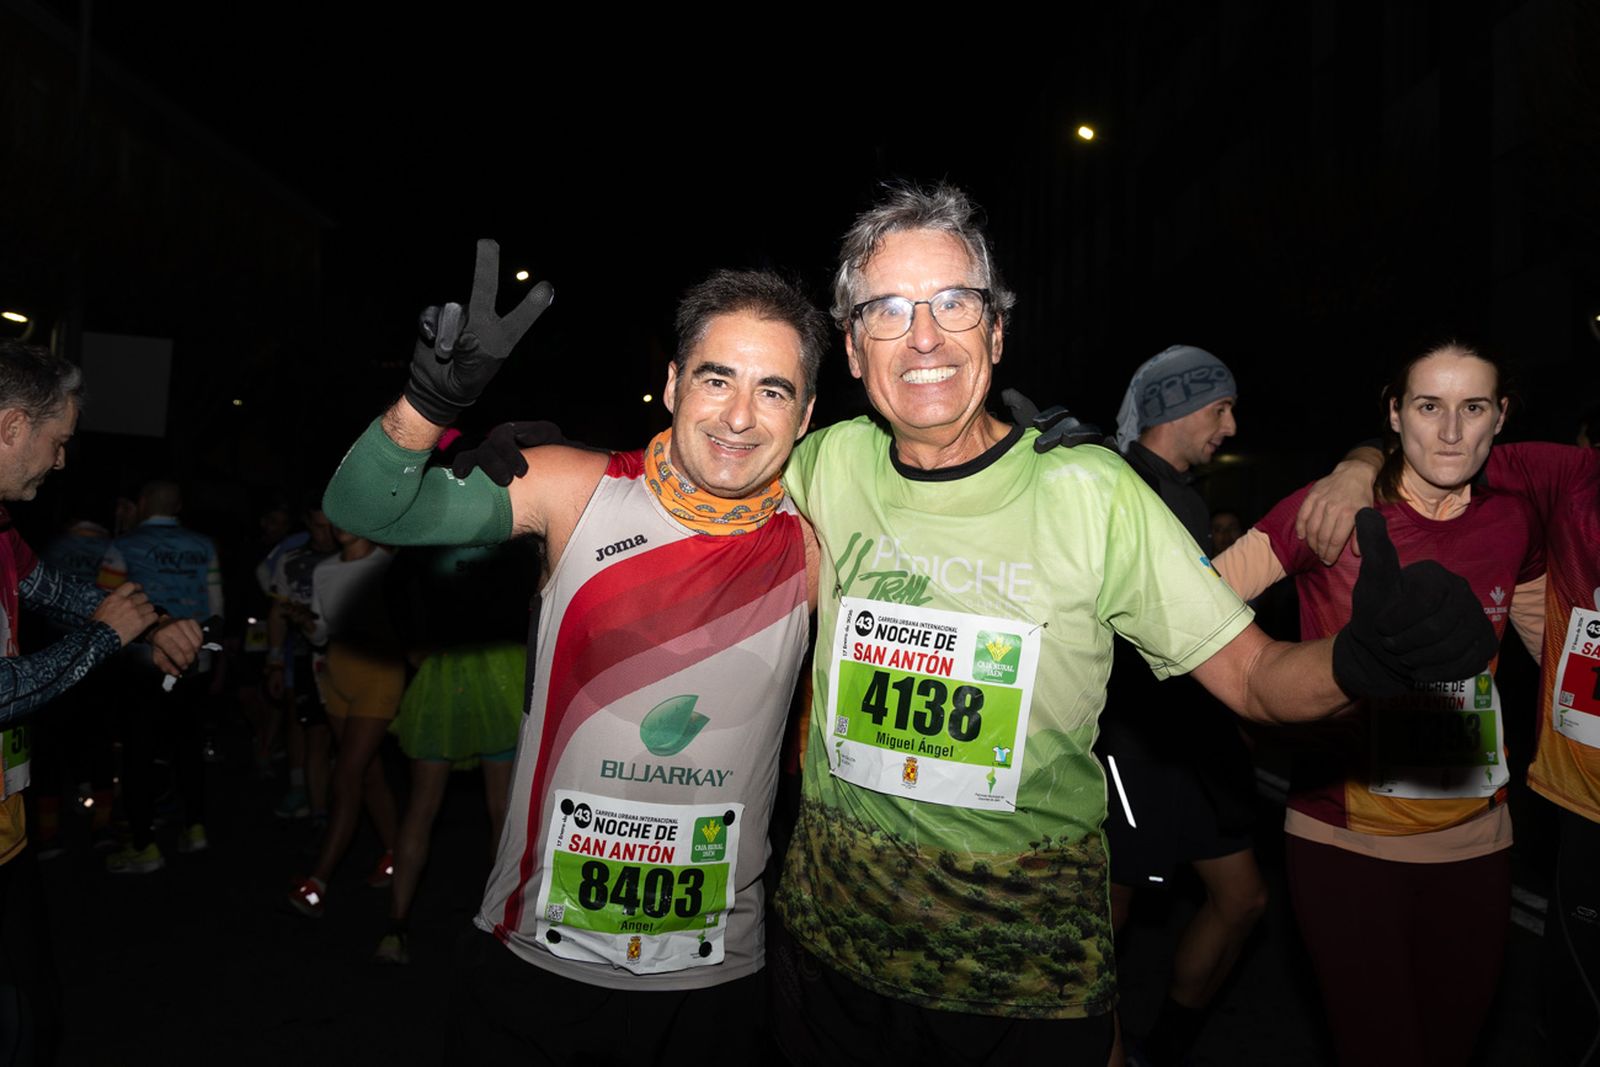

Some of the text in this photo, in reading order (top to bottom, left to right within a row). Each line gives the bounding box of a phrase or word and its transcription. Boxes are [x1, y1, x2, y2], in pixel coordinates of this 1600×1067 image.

[856, 616, 873, 630] 43
[878, 615, 958, 633] CARRERA URBANA INTERNACIONAL
[875, 624, 957, 652] NOCHE DE
[854, 642, 955, 677] SAN ANTÓN
[861, 670, 984, 742] 4138
[876, 732, 954, 759] Miguel Ángel
[600, 759, 729, 788] BUJARKAY
[574, 807, 592, 824] 43
[594, 816, 678, 842] NOCHE DE
[595, 809, 678, 825] CARRERA URBANA INTERNACIONAL
[568, 833, 676, 864] SAN ANTÓN
[578, 861, 705, 919] 8403
